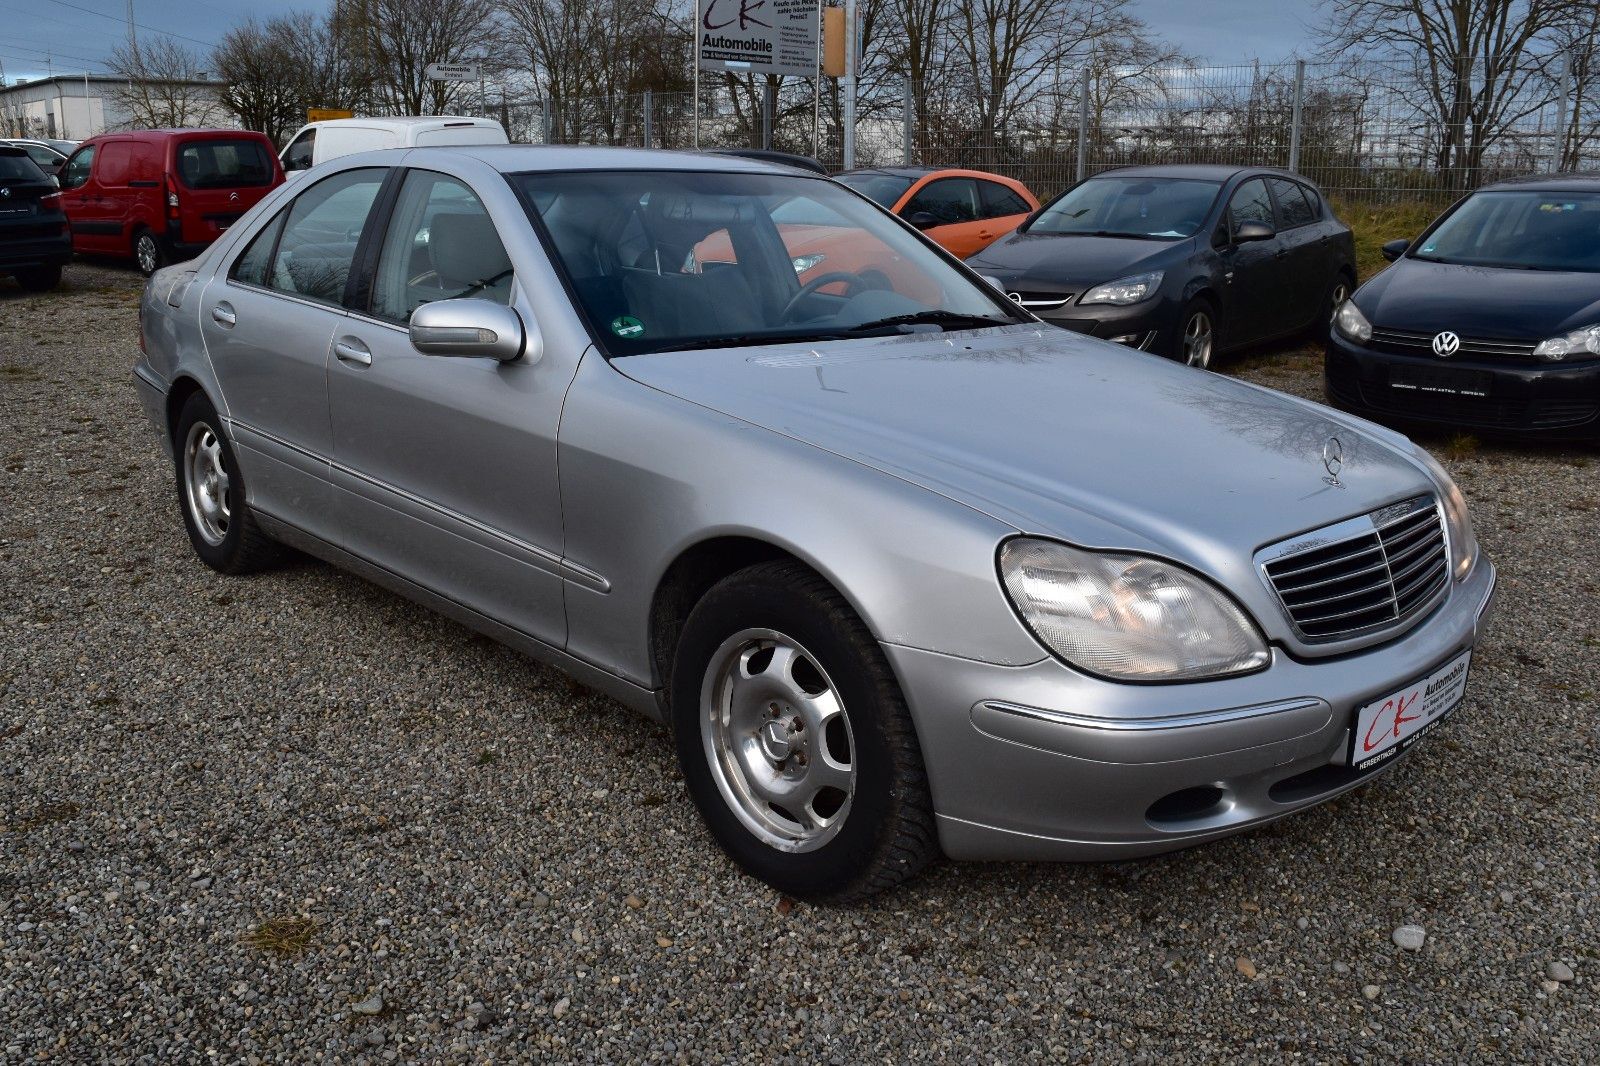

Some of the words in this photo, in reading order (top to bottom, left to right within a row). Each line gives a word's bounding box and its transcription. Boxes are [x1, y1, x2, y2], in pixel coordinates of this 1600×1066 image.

[702, 34, 772, 52] Automobile
[1424, 663, 1464, 697] Automobile
[1364, 691, 1421, 752] CK
[1360, 747, 1396, 770] HERBERTINGEN
